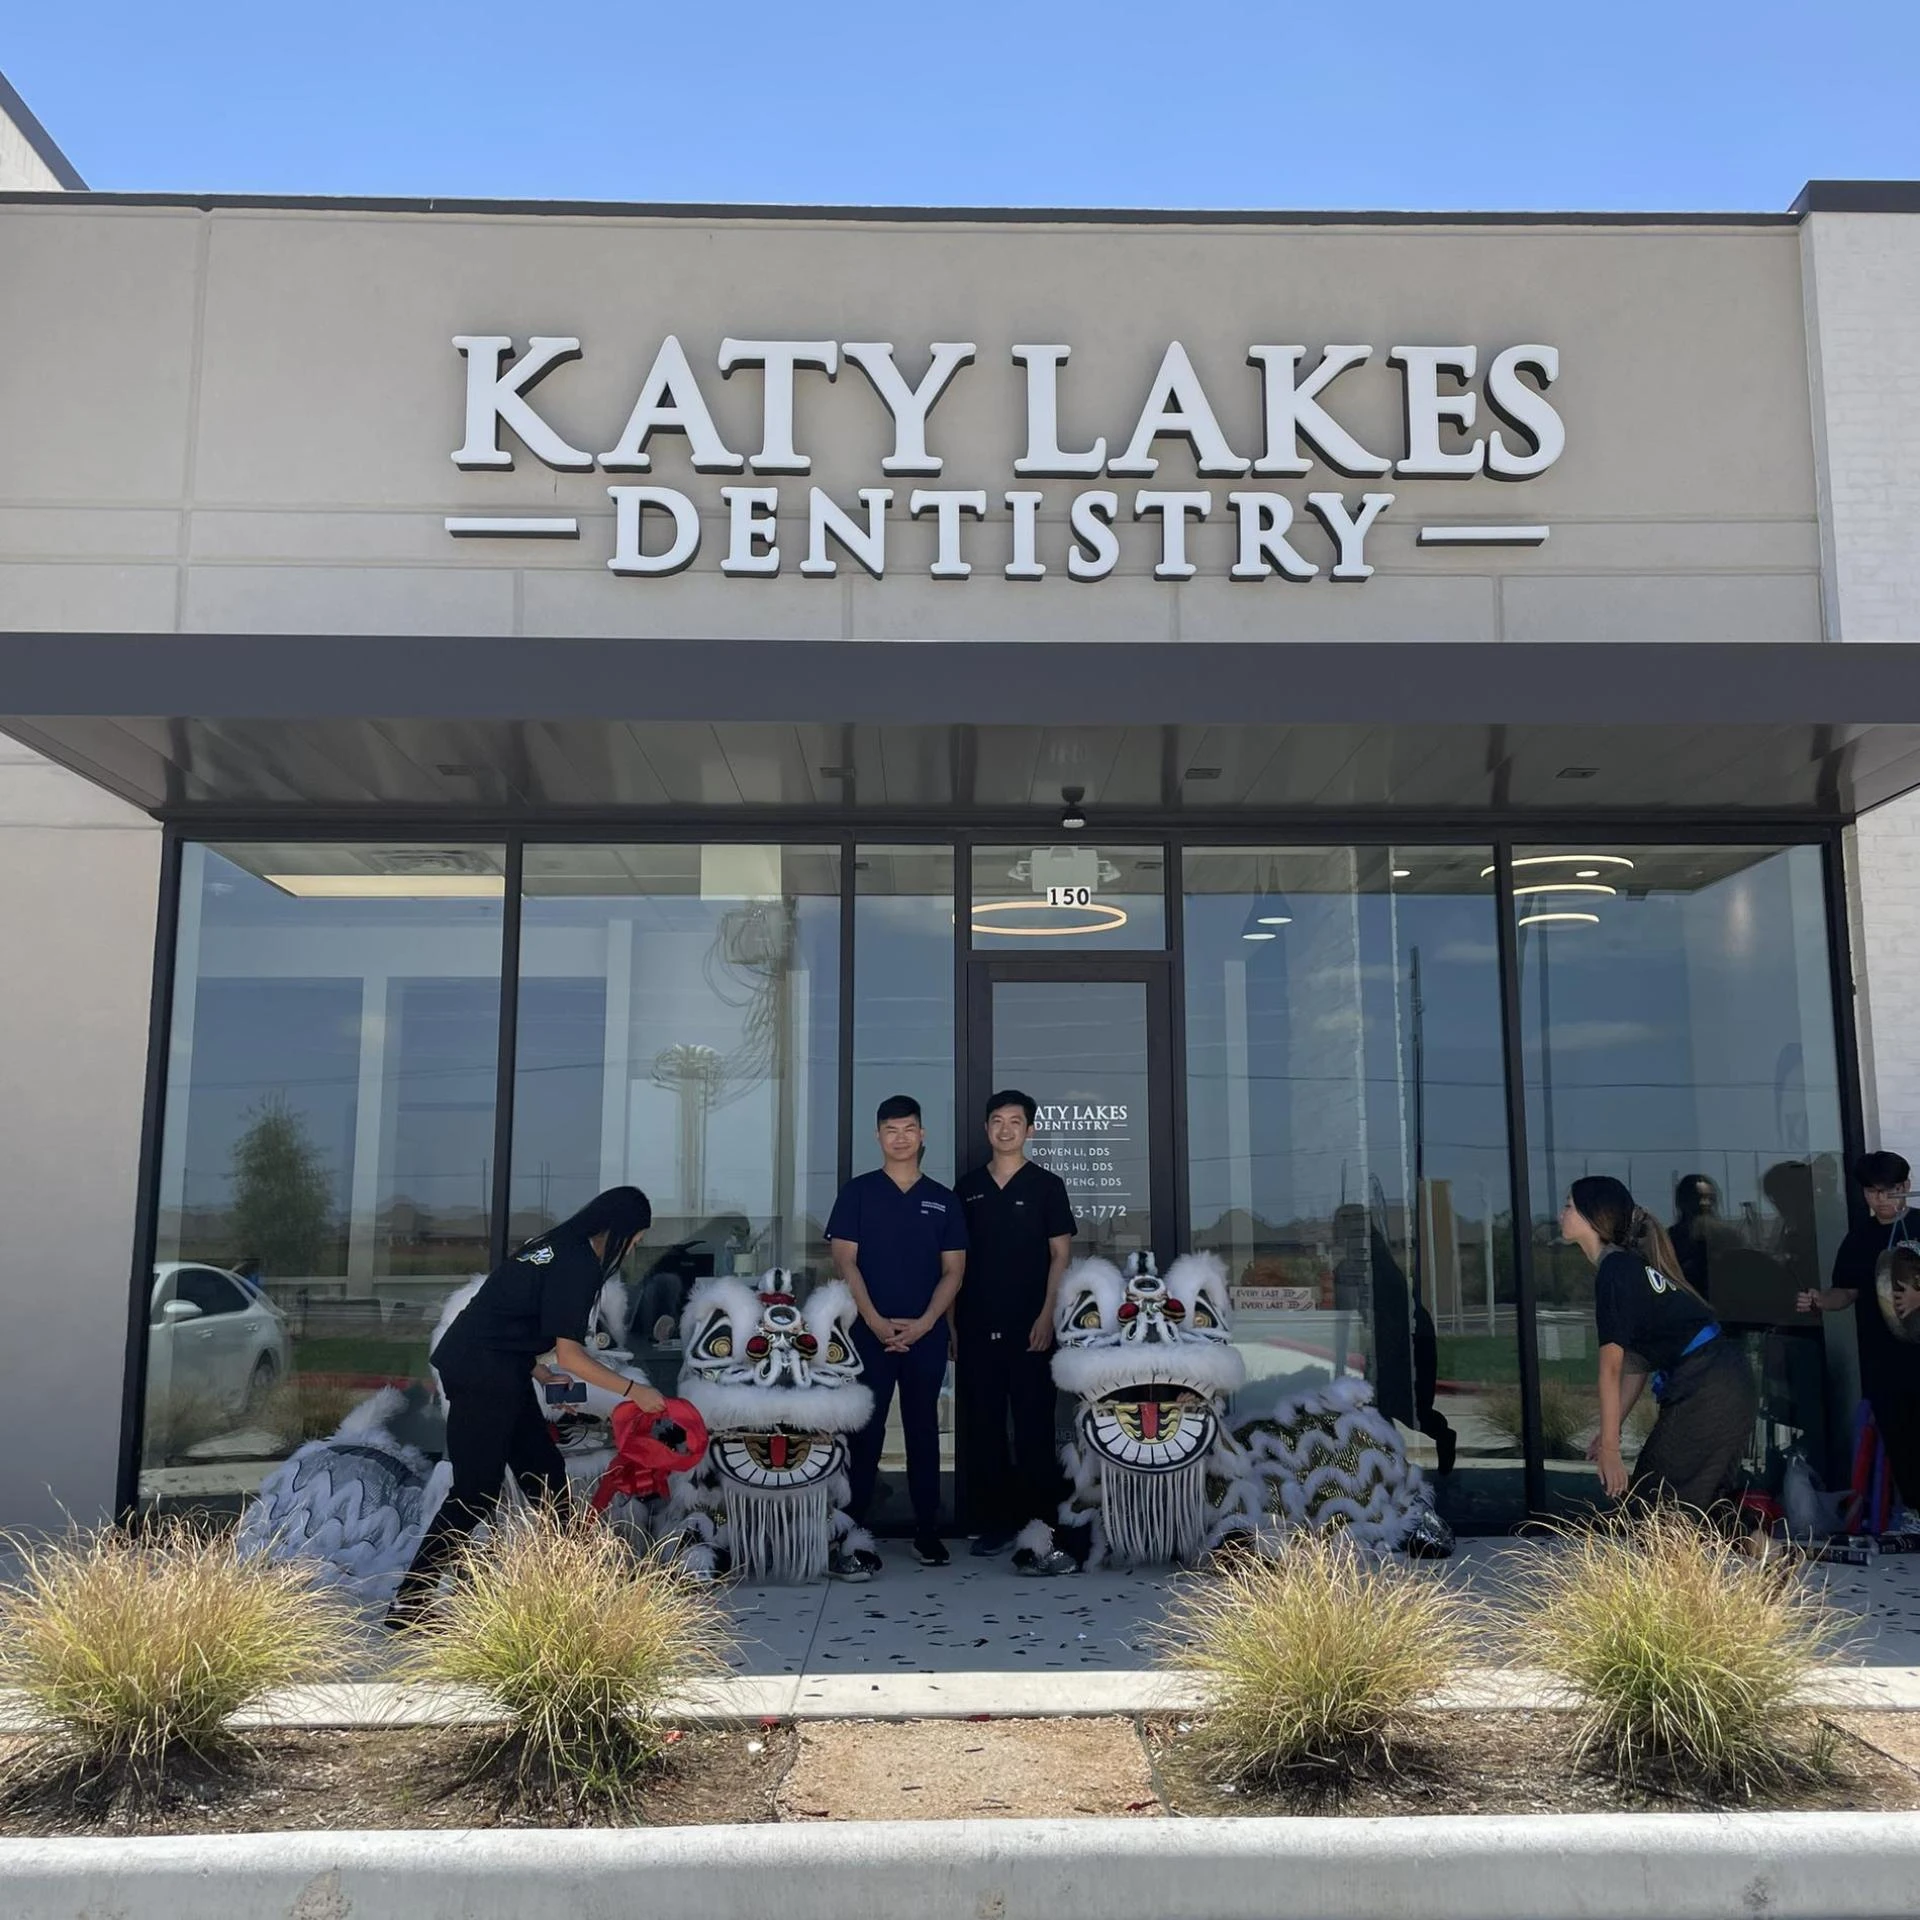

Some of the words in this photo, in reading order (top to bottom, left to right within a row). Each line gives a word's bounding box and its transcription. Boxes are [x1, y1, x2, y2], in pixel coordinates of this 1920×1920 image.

[450, 334, 977, 476] KATY
[1011, 340, 1566, 480] LAKES
[606, 485, 1396, 582] DENTISTRY
[1049, 887, 1090, 906] 150
[1034, 1105, 1070, 1120] ATY
[1073, 1105, 1128, 1120] LAKES
[1034, 1120, 1110, 1131] DENTISTRY
[1031, 1147, 1072, 1157] BOWEN
[1088, 1147, 1111, 1157] DDS
[1092, 1162, 1114, 1172] DDS
[1101, 1177, 1123, 1187] DDS
[1070, 1205, 1127, 1219] 3-1772
